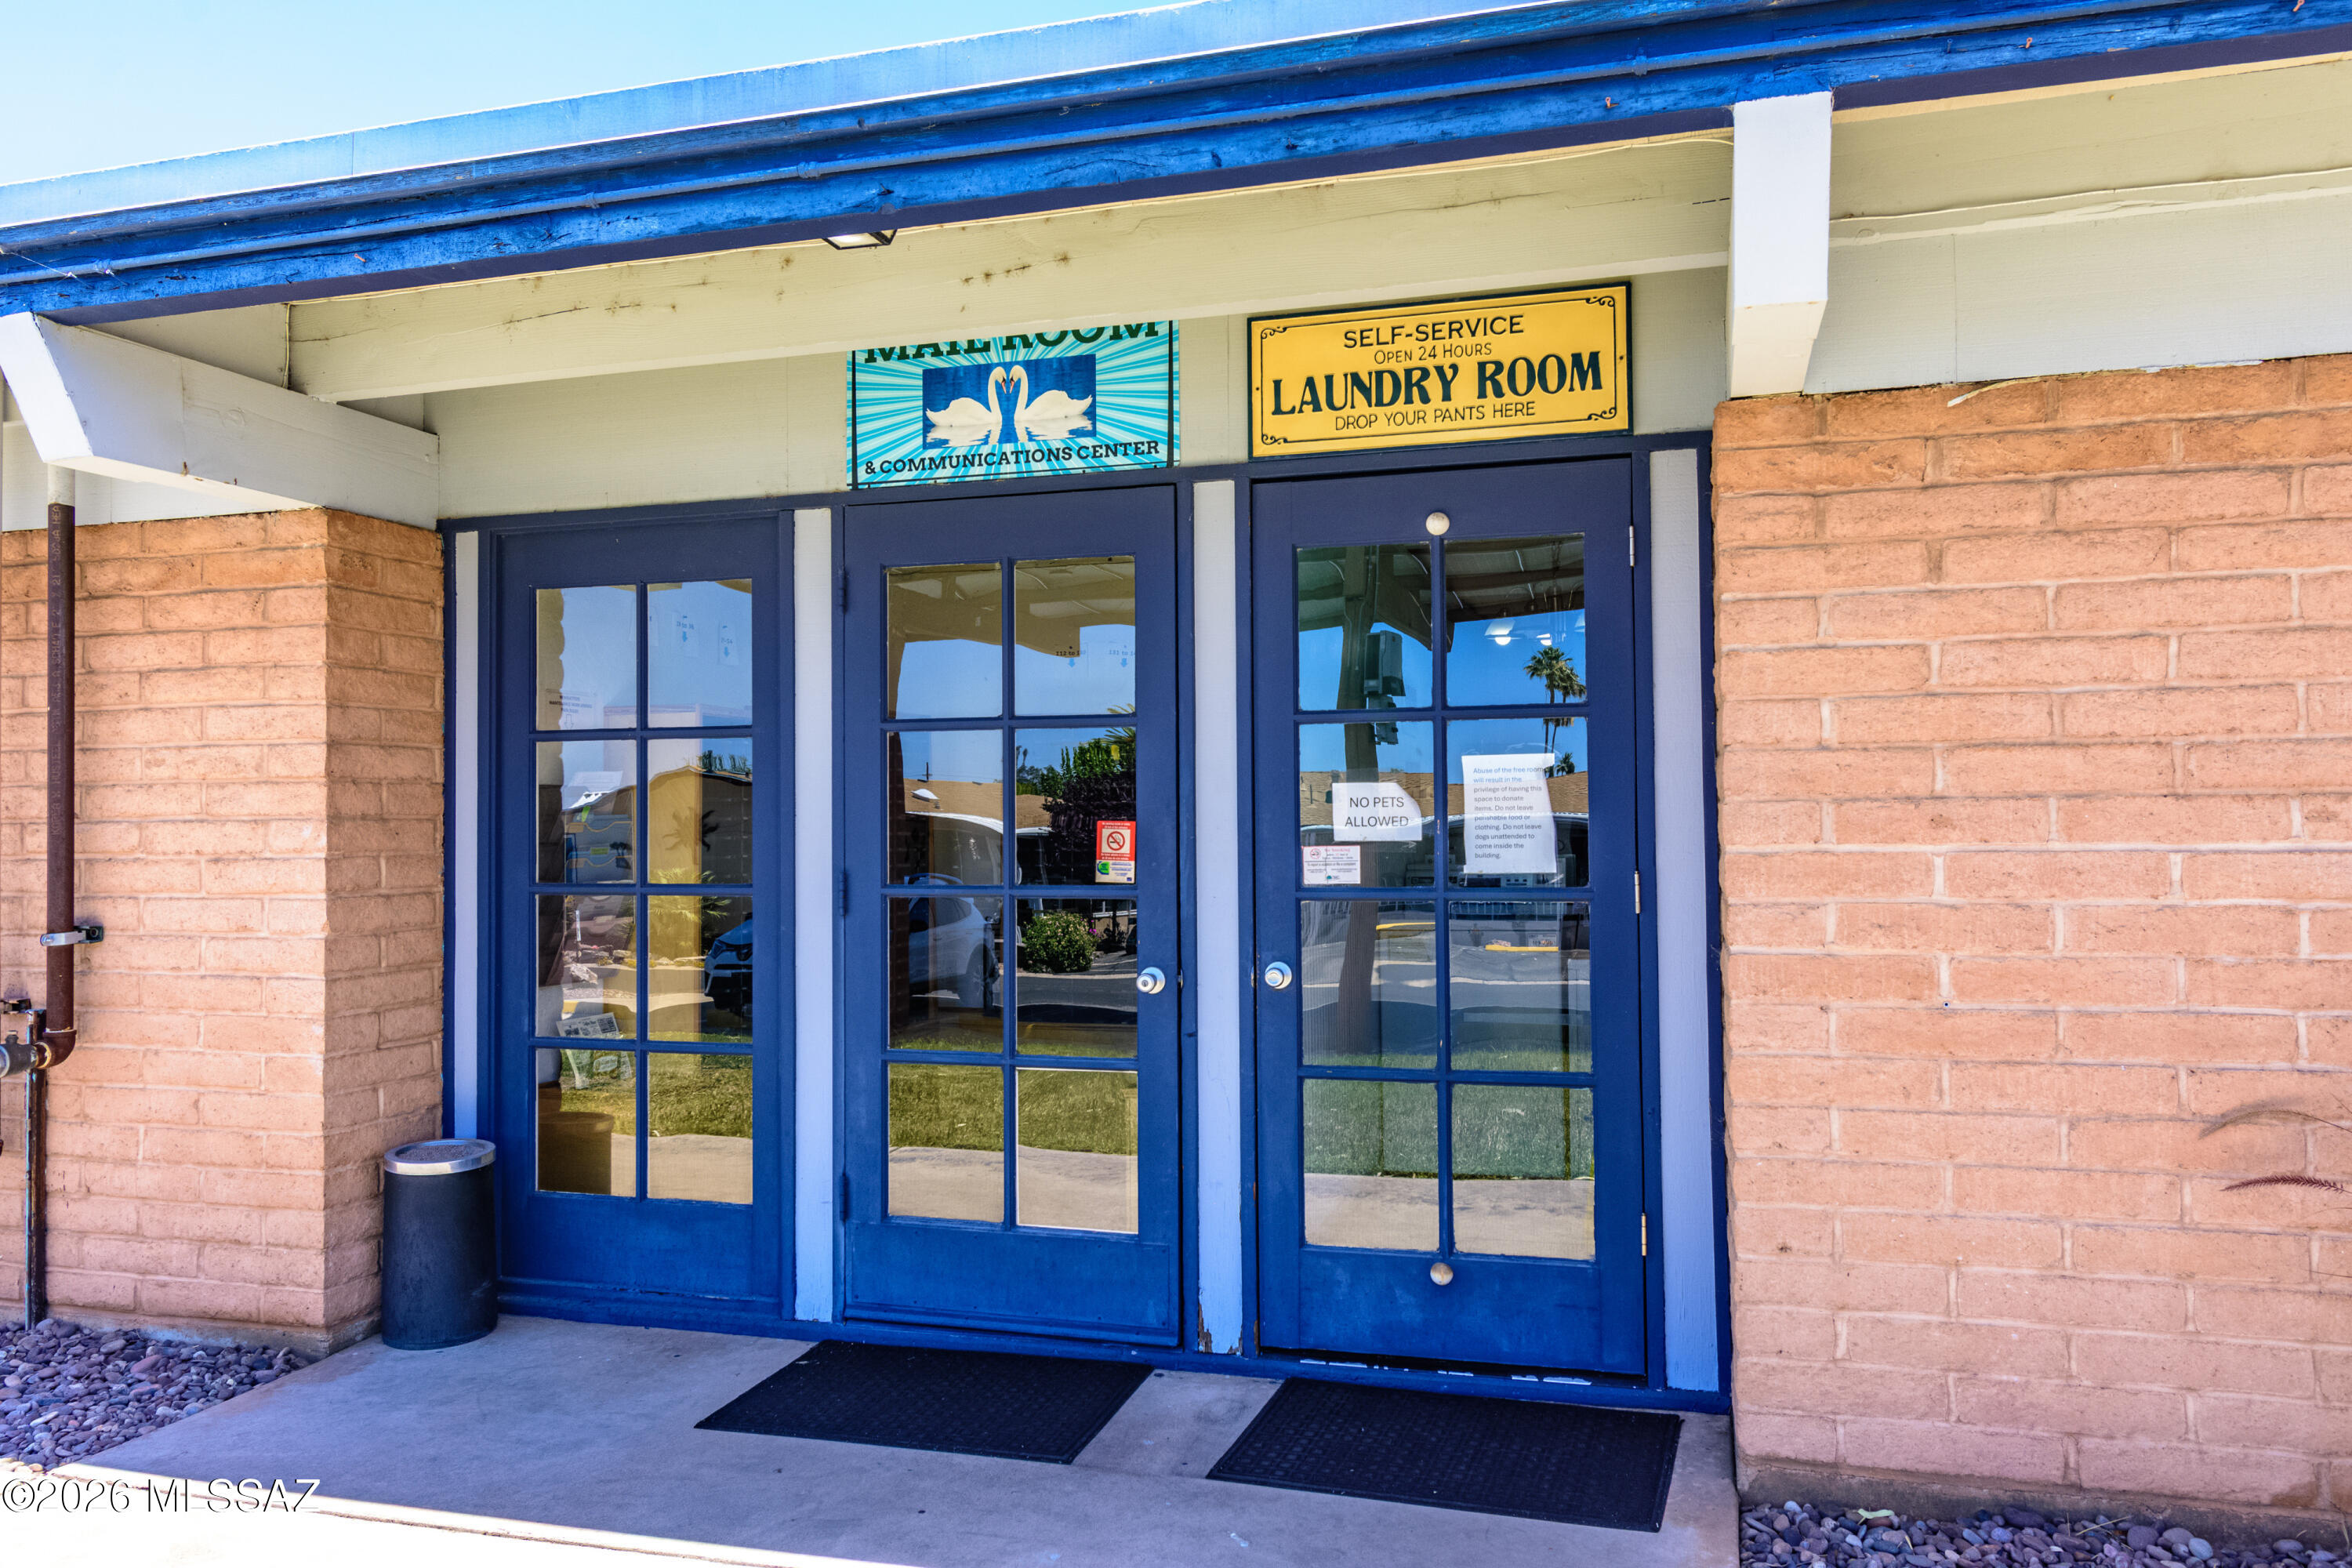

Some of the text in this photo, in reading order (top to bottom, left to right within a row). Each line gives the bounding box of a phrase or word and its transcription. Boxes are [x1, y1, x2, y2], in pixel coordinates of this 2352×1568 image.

[1343, 314, 1525, 349] SELF-SERVICE
[1418, 346, 1437, 361] 24
[1271, 350, 1602, 416] LAUNDRY ROOM
[1335, 401, 1536, 431] DROP YOUR PANTS HERE
[865, 440, 1160, 475] & COMMUNICATIONS CENTER
[1349, 797, 1405, 808] NO PETS
[1345, 816, 1409, 827] ALLOWED
